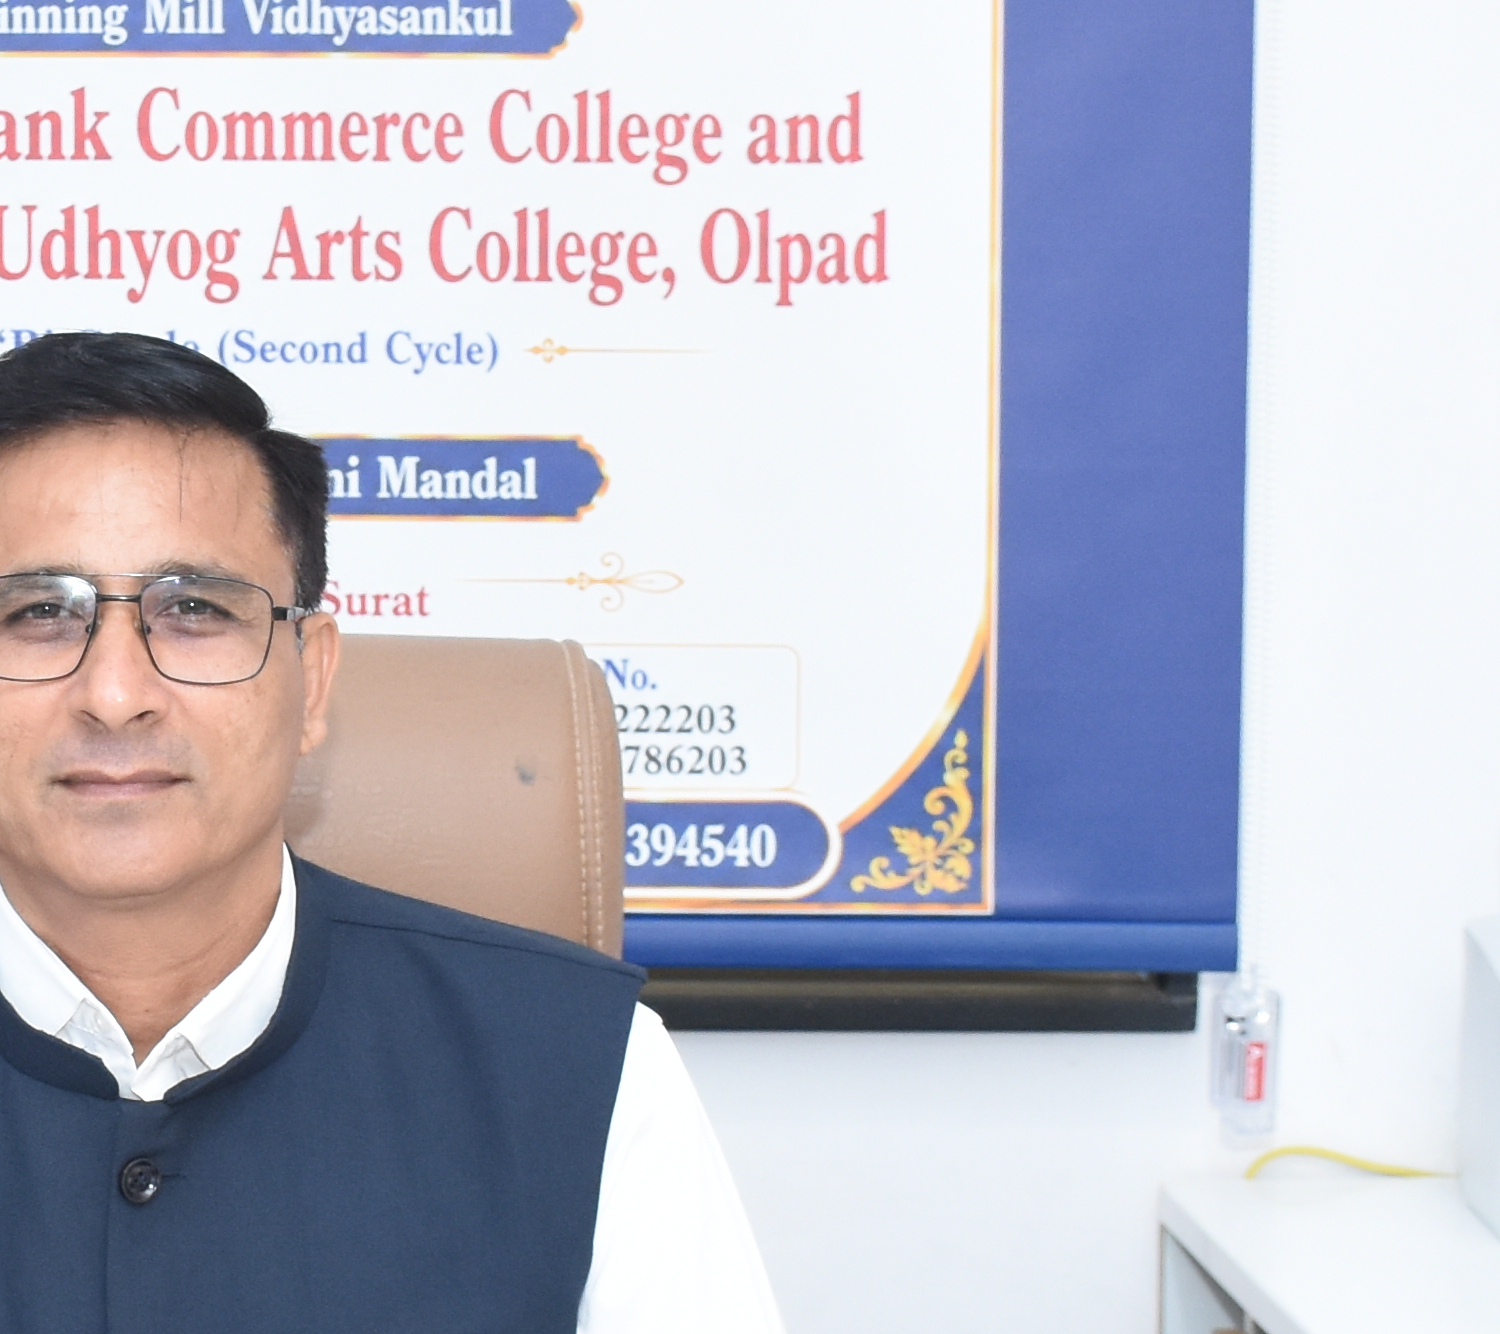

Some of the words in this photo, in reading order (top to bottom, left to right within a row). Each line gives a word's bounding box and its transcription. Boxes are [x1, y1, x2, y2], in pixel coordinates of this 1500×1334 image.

[138, 87, 464, 163] Commerce
[489, 89, 722, 185] College
[748, 92, 863, 164] and
[264, 207, 403, 281] Arts
[429, 207, 676, 306] College,
[700, 208, 888, 307] Olpad
[219, 330, 368, 365] (Second
[386, 331, 499, 374] Cycle)
[377, 456, 537, 499] Mandal
[322, 581, 430, 617] Surat
[603, 658, 657, 690] No.
[625, 823, 777, 867] 394540
